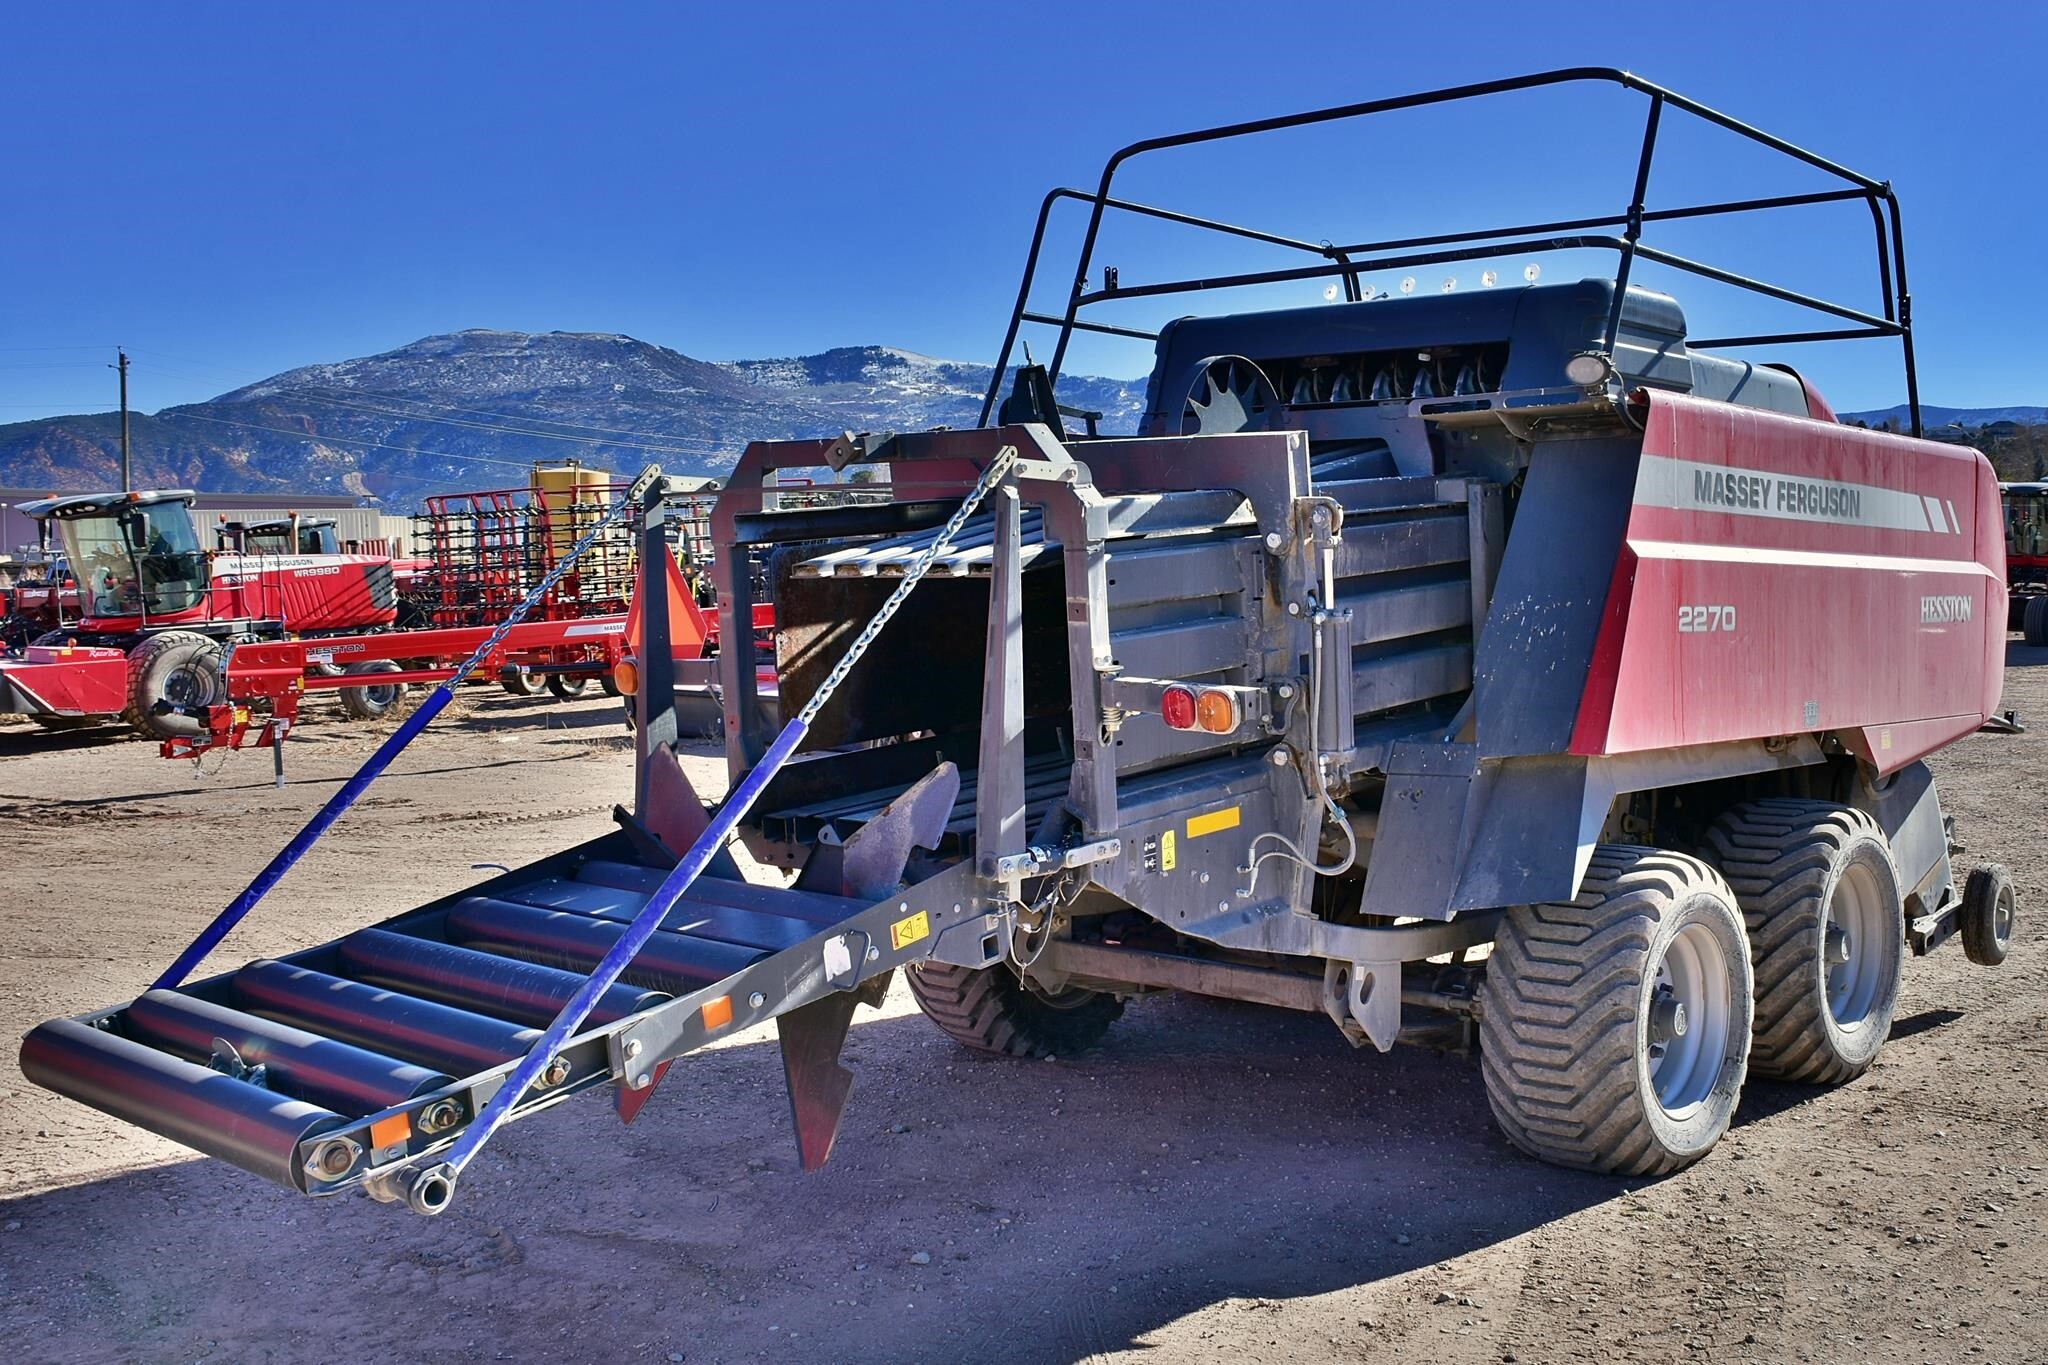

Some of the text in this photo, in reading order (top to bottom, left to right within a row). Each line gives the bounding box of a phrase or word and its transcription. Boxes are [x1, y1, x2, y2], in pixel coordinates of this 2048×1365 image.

[1695, 469, 1861, 519] MASSEY FERGUSON
[229, 559, 314, 569] MASSE FERGUSON
[294, 566, 340, 578] WR9980
[1678, 605, 1737, 632] 2270
[1920, 594, 1972, 623] HESSTON
[305, 643, 366, 656] HESSTON
